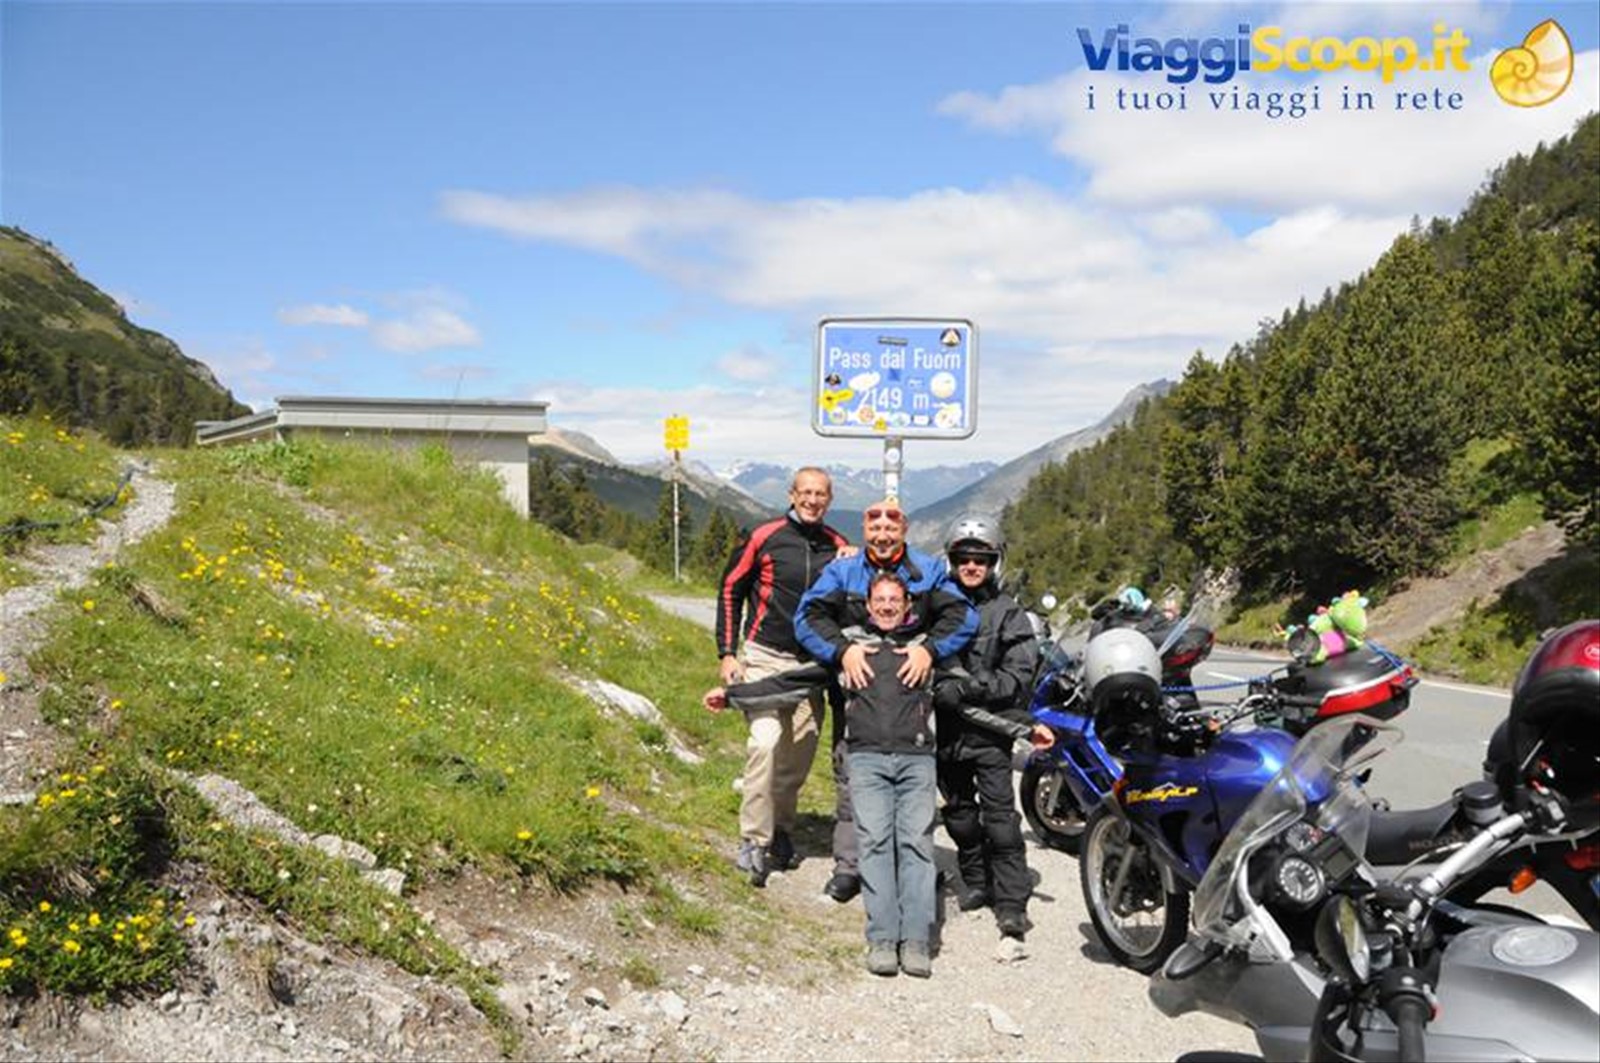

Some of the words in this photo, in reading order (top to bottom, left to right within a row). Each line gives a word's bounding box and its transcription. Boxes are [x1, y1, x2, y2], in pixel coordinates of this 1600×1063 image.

[829, 347, 872, 369] Pass
[880, 348, 905, 369] dal
[913, 348, 961, 369] Fuorn
[912, 391, 929, 409] m
